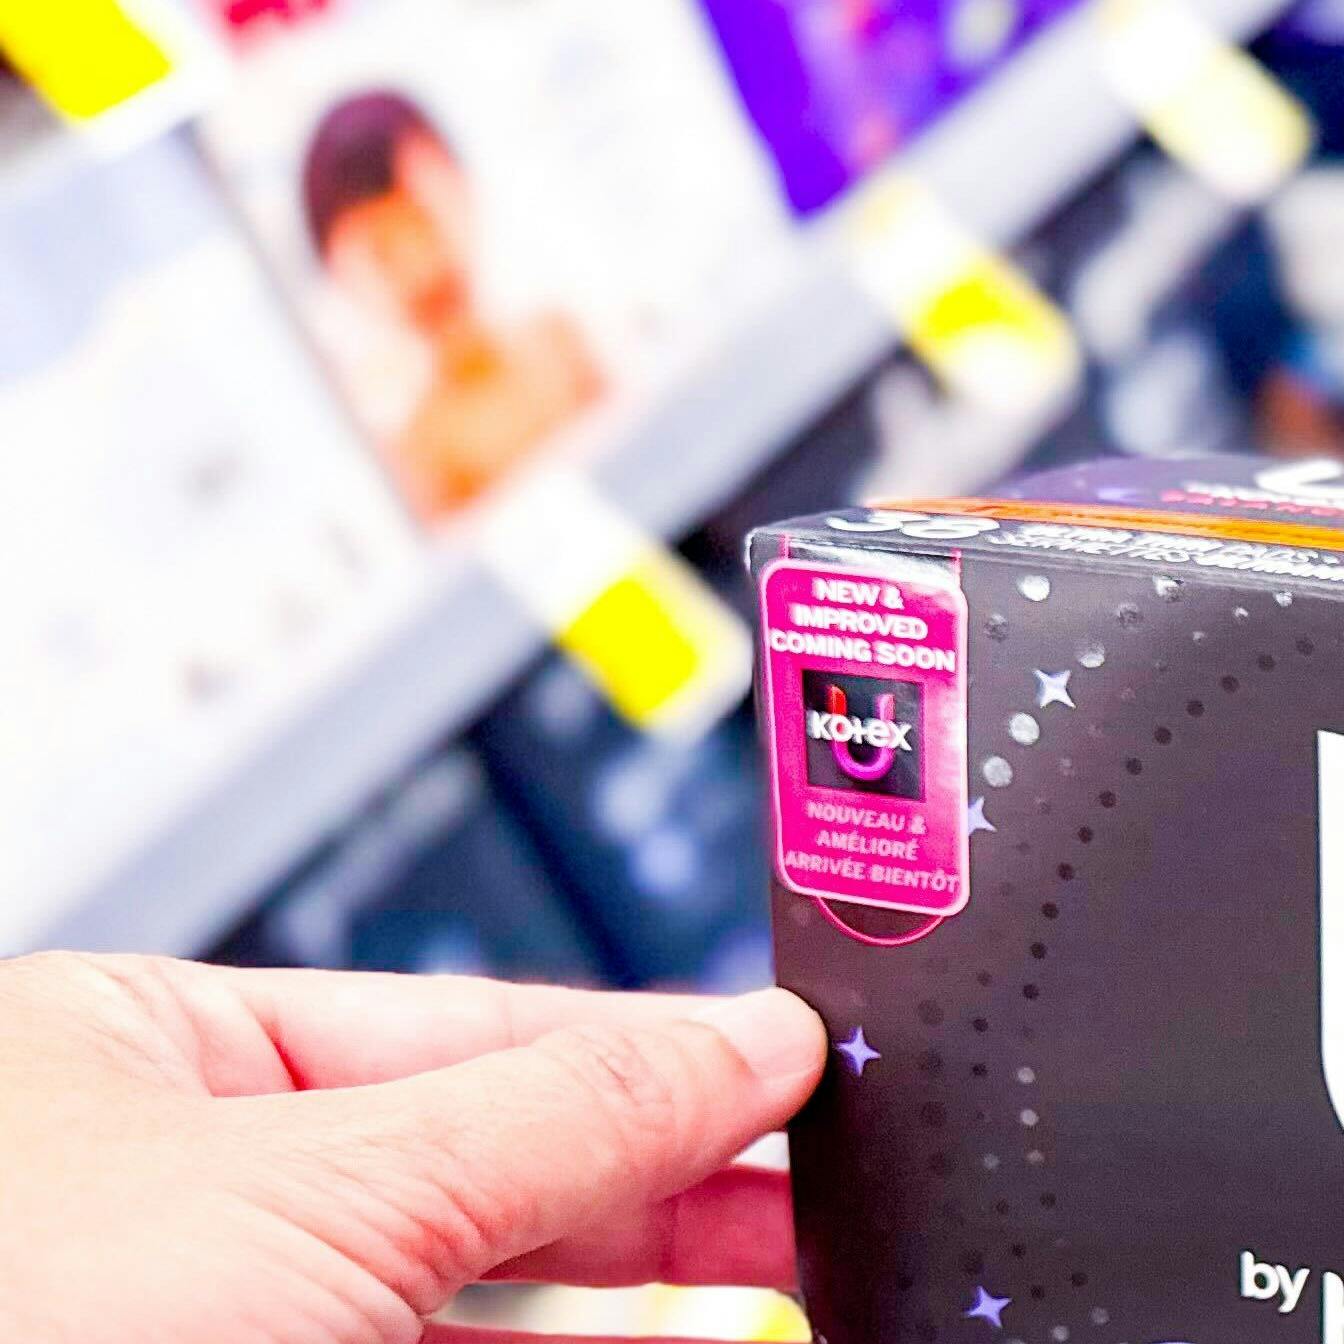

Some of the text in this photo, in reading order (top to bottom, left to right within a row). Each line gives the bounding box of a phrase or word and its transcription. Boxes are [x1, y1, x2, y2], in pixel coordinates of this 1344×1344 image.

[812, 577, 905, 609] NEW &
[789, 603, 928, 640] IMPROVED
[770, 628, 956, 673] COMING SOON
[806, 801, 927, 835] NOUVEAU &
[816, 829, 920, 861] AMÉLIORÉ
[785, 850, 960, 894] ARRIVÉE BIENTÔT
[1240, 1250, 1309, 1313] by
